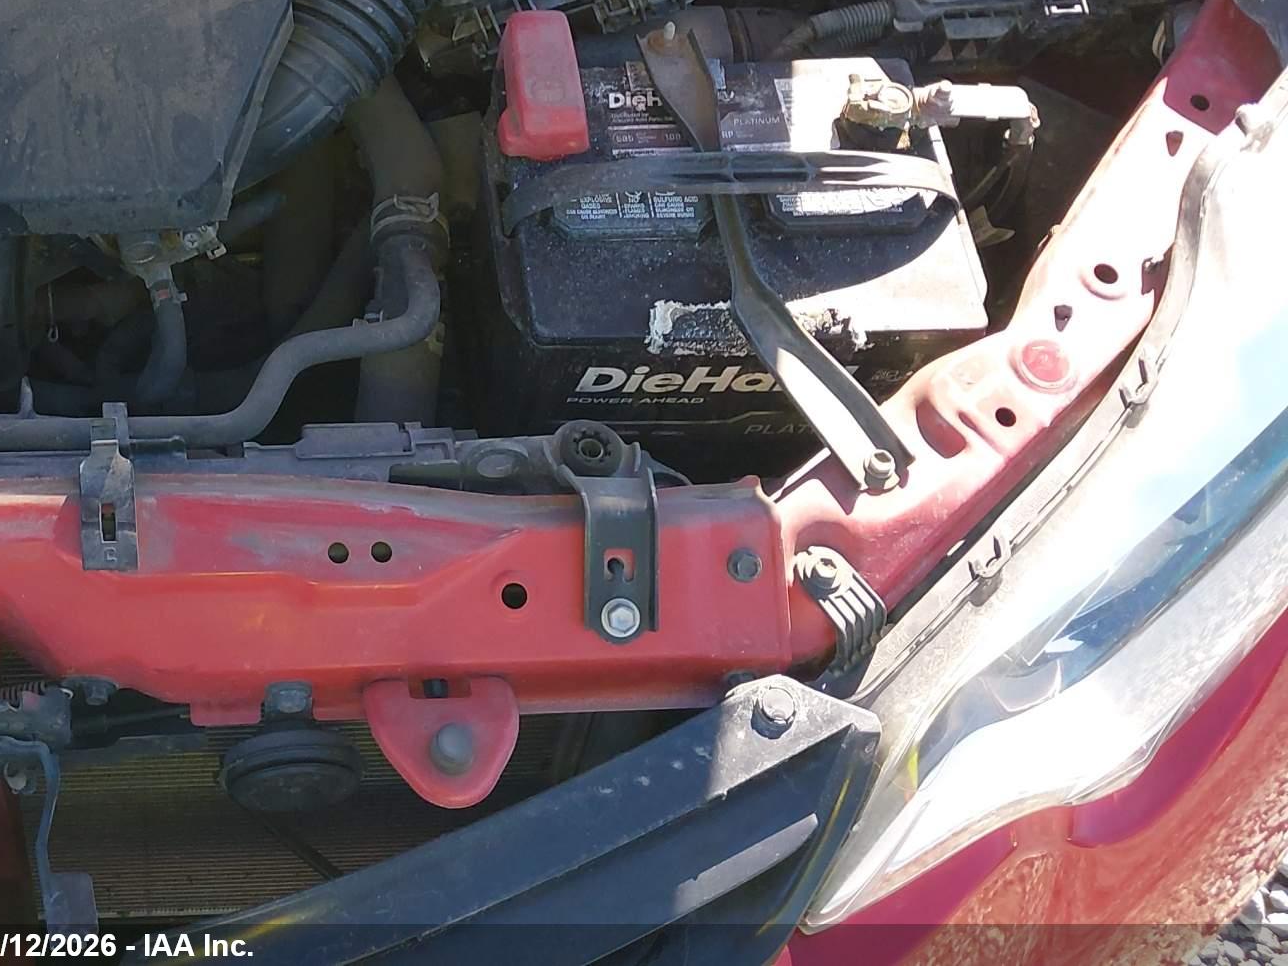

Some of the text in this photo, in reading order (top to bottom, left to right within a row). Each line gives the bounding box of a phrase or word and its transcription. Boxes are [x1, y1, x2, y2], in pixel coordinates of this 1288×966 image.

[733, 117, 780, 127] PLATINUM
[684, 195, 698, 203] ACID
[574, 365, 858, 394] DieHa
[566, 397, 705, 405] POWER AHEAD
